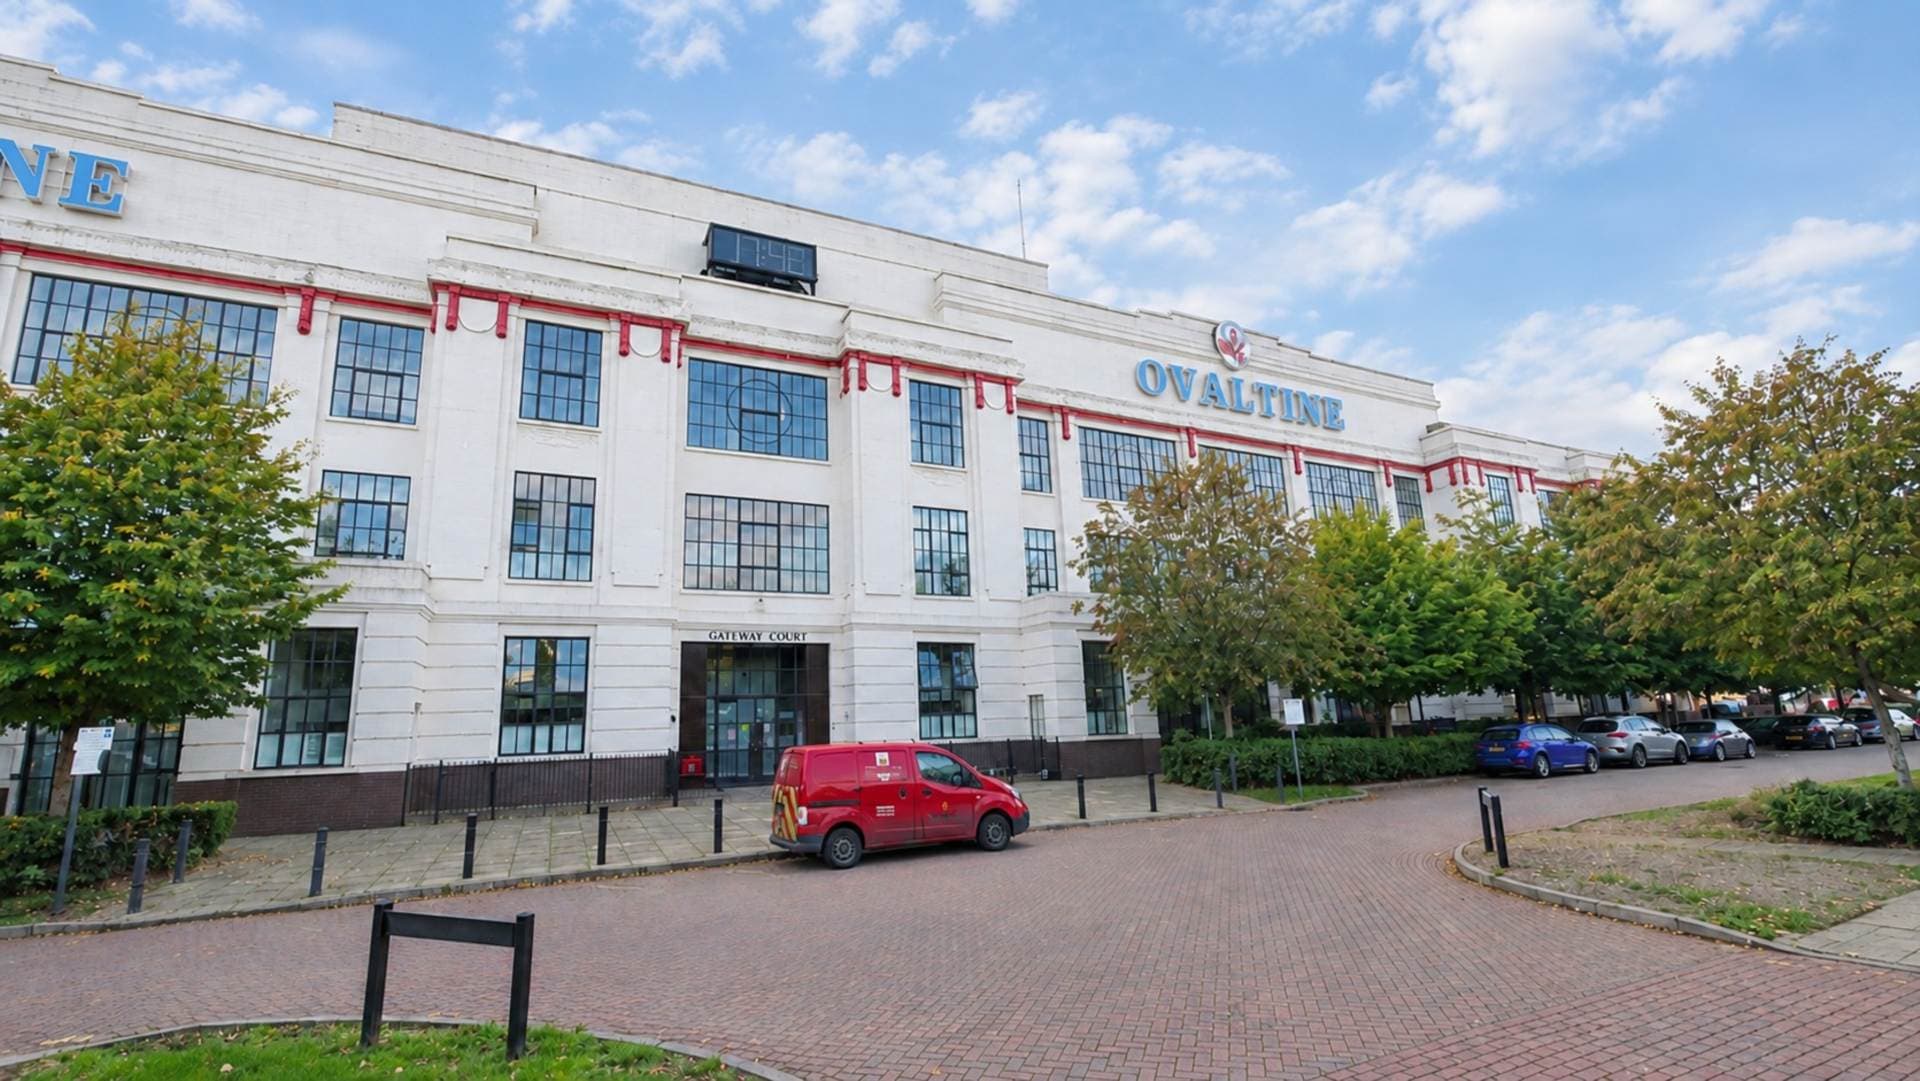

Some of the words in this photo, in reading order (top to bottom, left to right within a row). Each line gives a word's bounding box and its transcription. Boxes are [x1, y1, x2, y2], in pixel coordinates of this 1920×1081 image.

[1134, 357, 1346, 431] OVALTINE
[708, 631, 763, 641] GATEWAY
[769, 631, 808, 642] COURT
